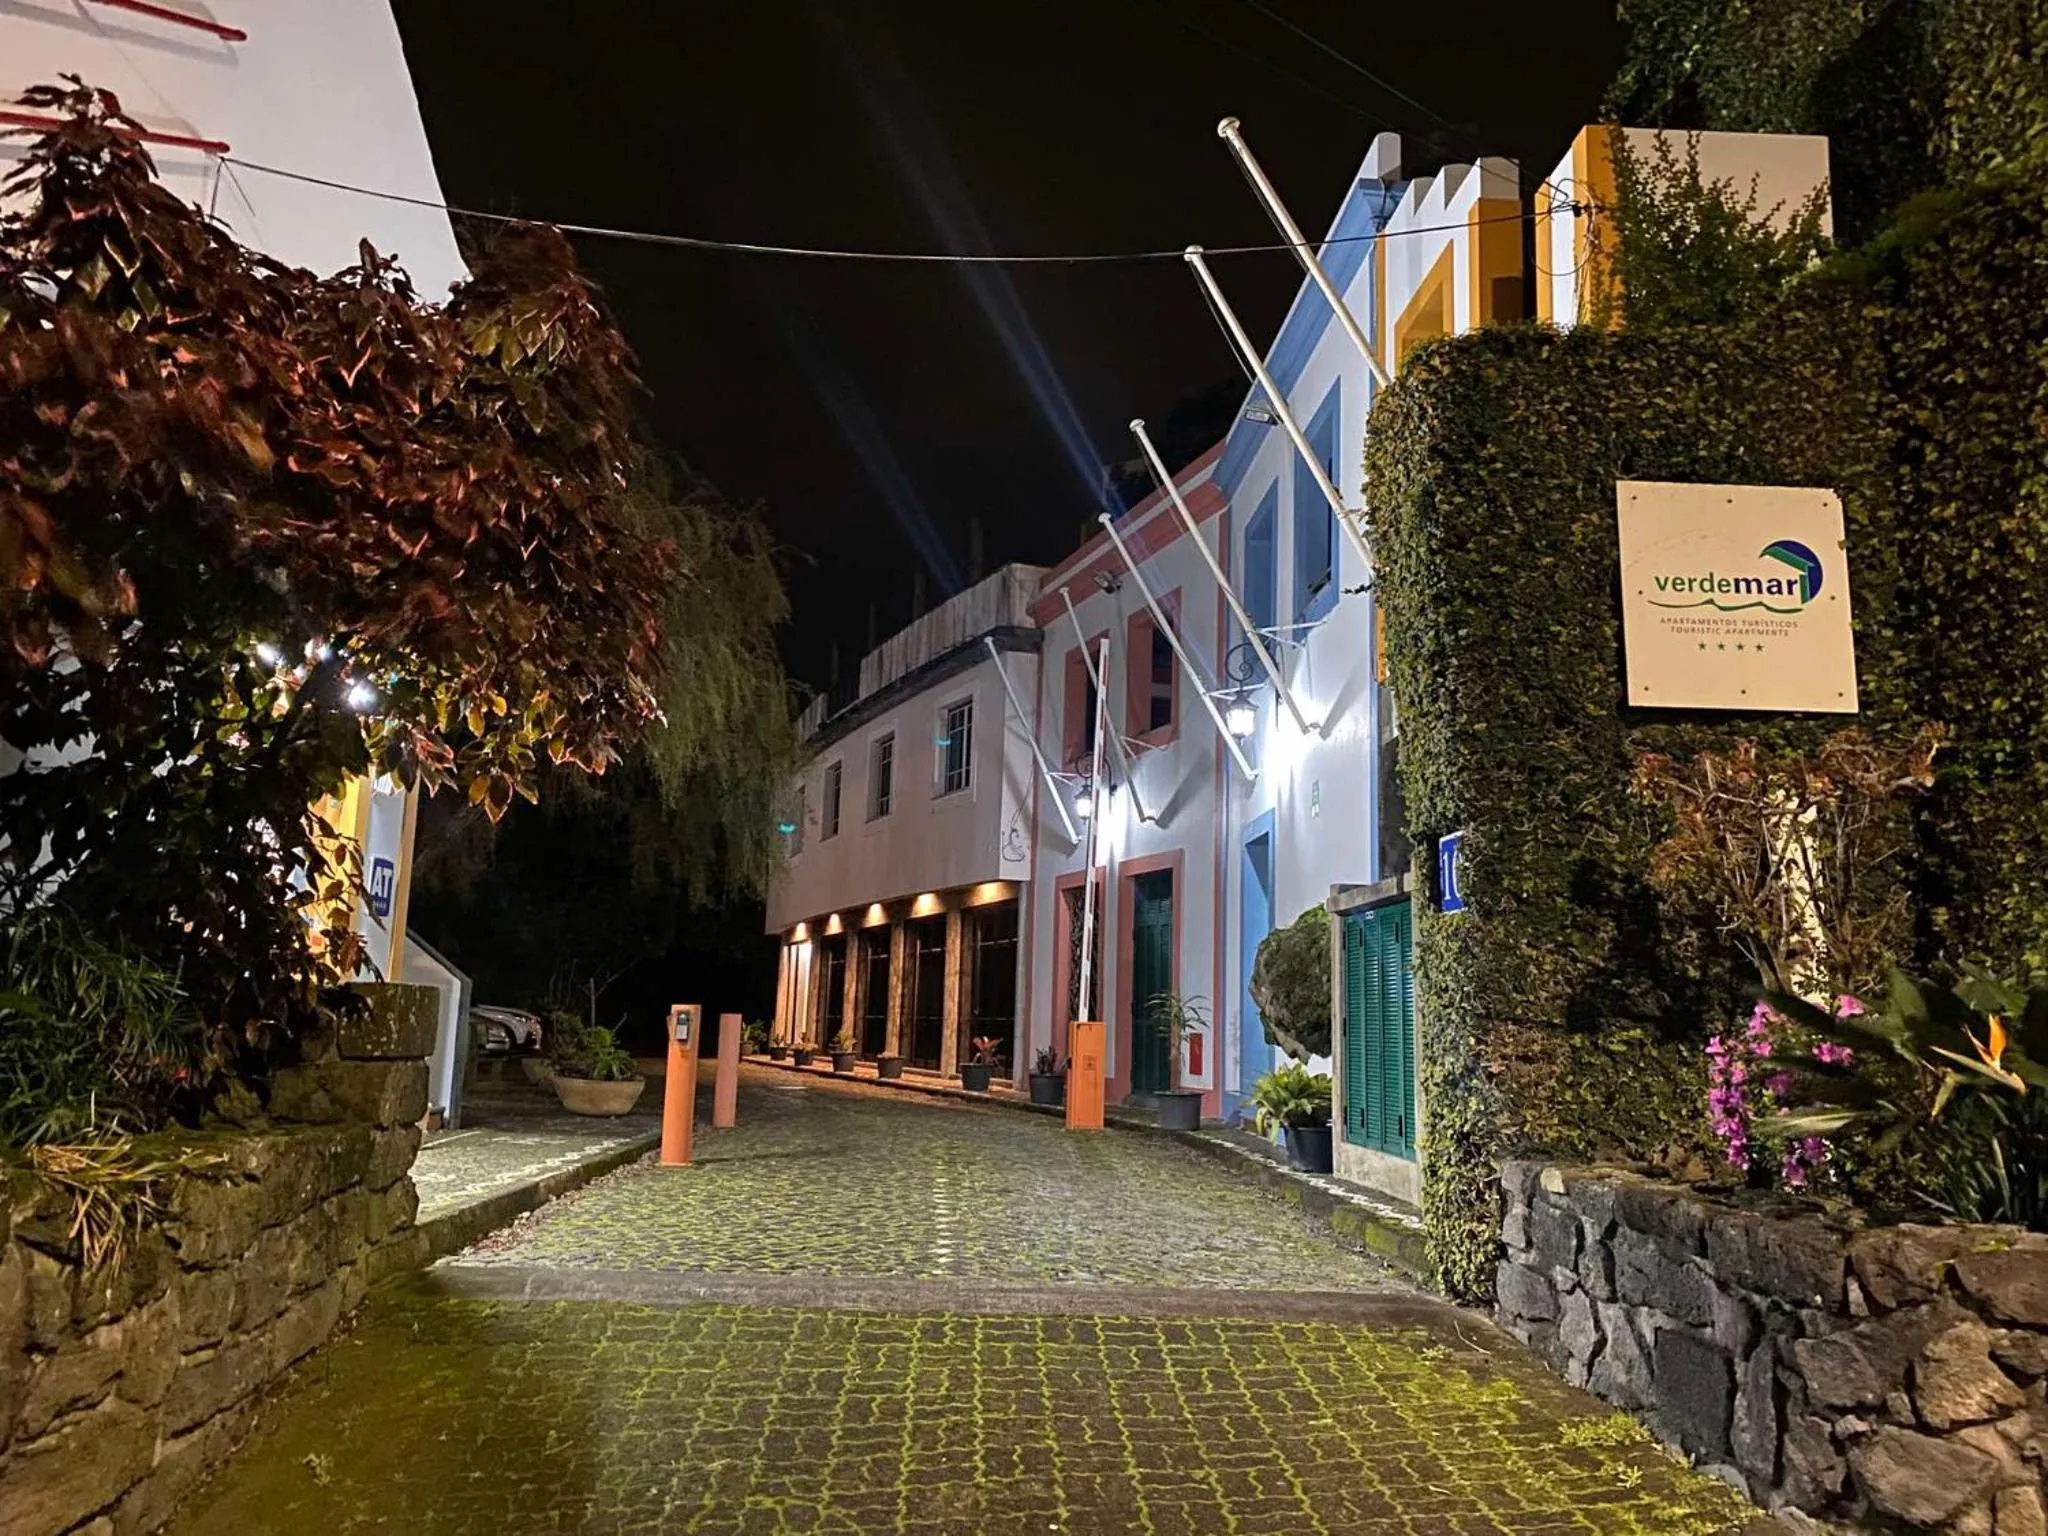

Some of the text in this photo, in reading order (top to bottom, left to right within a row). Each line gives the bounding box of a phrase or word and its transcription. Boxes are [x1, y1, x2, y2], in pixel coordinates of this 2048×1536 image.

[1654, 572, 1798, 595] verdemar
[1660, 617, 1738, 627] APARTAMENTOS
[1670, 626, 1789, 637] TOURISTIC APARTMENTS
[371, 866, 393, 898] AT
